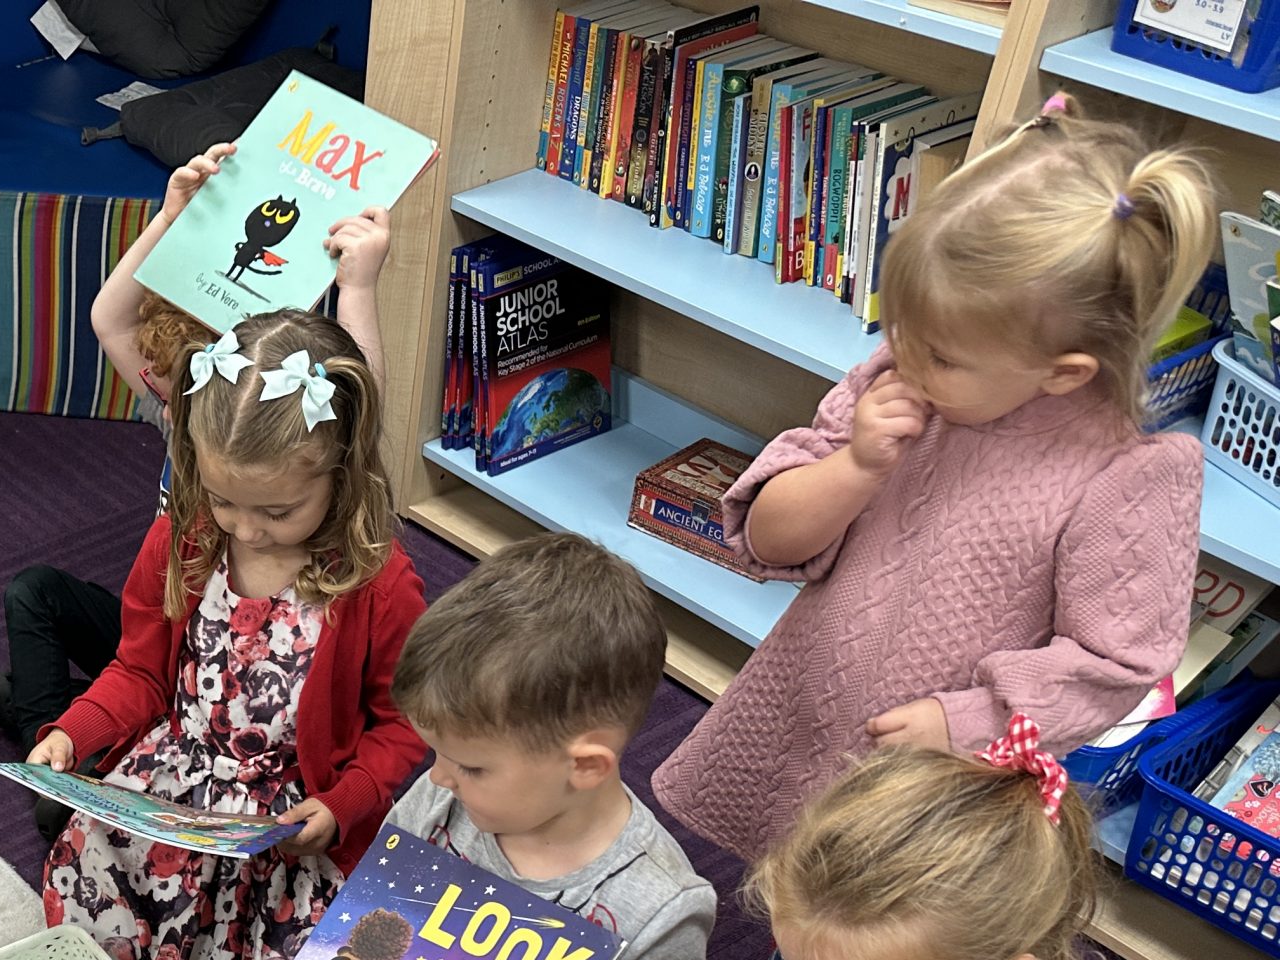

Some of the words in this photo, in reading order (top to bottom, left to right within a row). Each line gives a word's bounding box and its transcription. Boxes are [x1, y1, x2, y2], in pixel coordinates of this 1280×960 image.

[1212, 4, 1224, 14] 3.9
[1221, 32, 1231, 40] LY
[559, 41, 571, 84] MICHAEL
[585, 65, 593, 80] BOOK
[638, 65, 653, 114] JACKSON
[647, 75, 655, 105] PERCY
[570, 96, 581, 140] DRAGONS
[578, 115, 587, 138] STORIES
[600, 115, 609, 152] MAGICIANS
[681, 103, 689, 144] SPOTLIGHT
[748, 118, 758, 150] MOON
[755, 112, 767, 155] CLOVER
[277, 108, 385, 191] Max
[279, 161, 297, 177] the
[295, 169, 337, 200] Brave
[697, 174, 708, 214] Palacio
[829, 168, 842, 224] BOGWOPPIT
[762, 197, 776, 238] Palacio
[523, 259, 553, 275] SCHOOL
[195, 273, 207, 290] by
[205, 283, 221, 298] Ed
[220, 290, 239, 311] Vere
[495, 279, 558, 317] JUNIOR
[496, 297, 565, 336] SCHOOL
[496, 322, 549, 356] ATLAS
[497, 348, 537, 368] Recommended
[538, 345, 548, 355] for
[498, 367, 509, 376] Key
[509, 363, 525, 374] Stage
[526, 360, 530, 368] 2
[536, 355, 545, 364] the
[546, 347, 568, 361] National
[568, 334, 598, 351] Curriculum
[658, 506, 704, 532] ANCIENT
